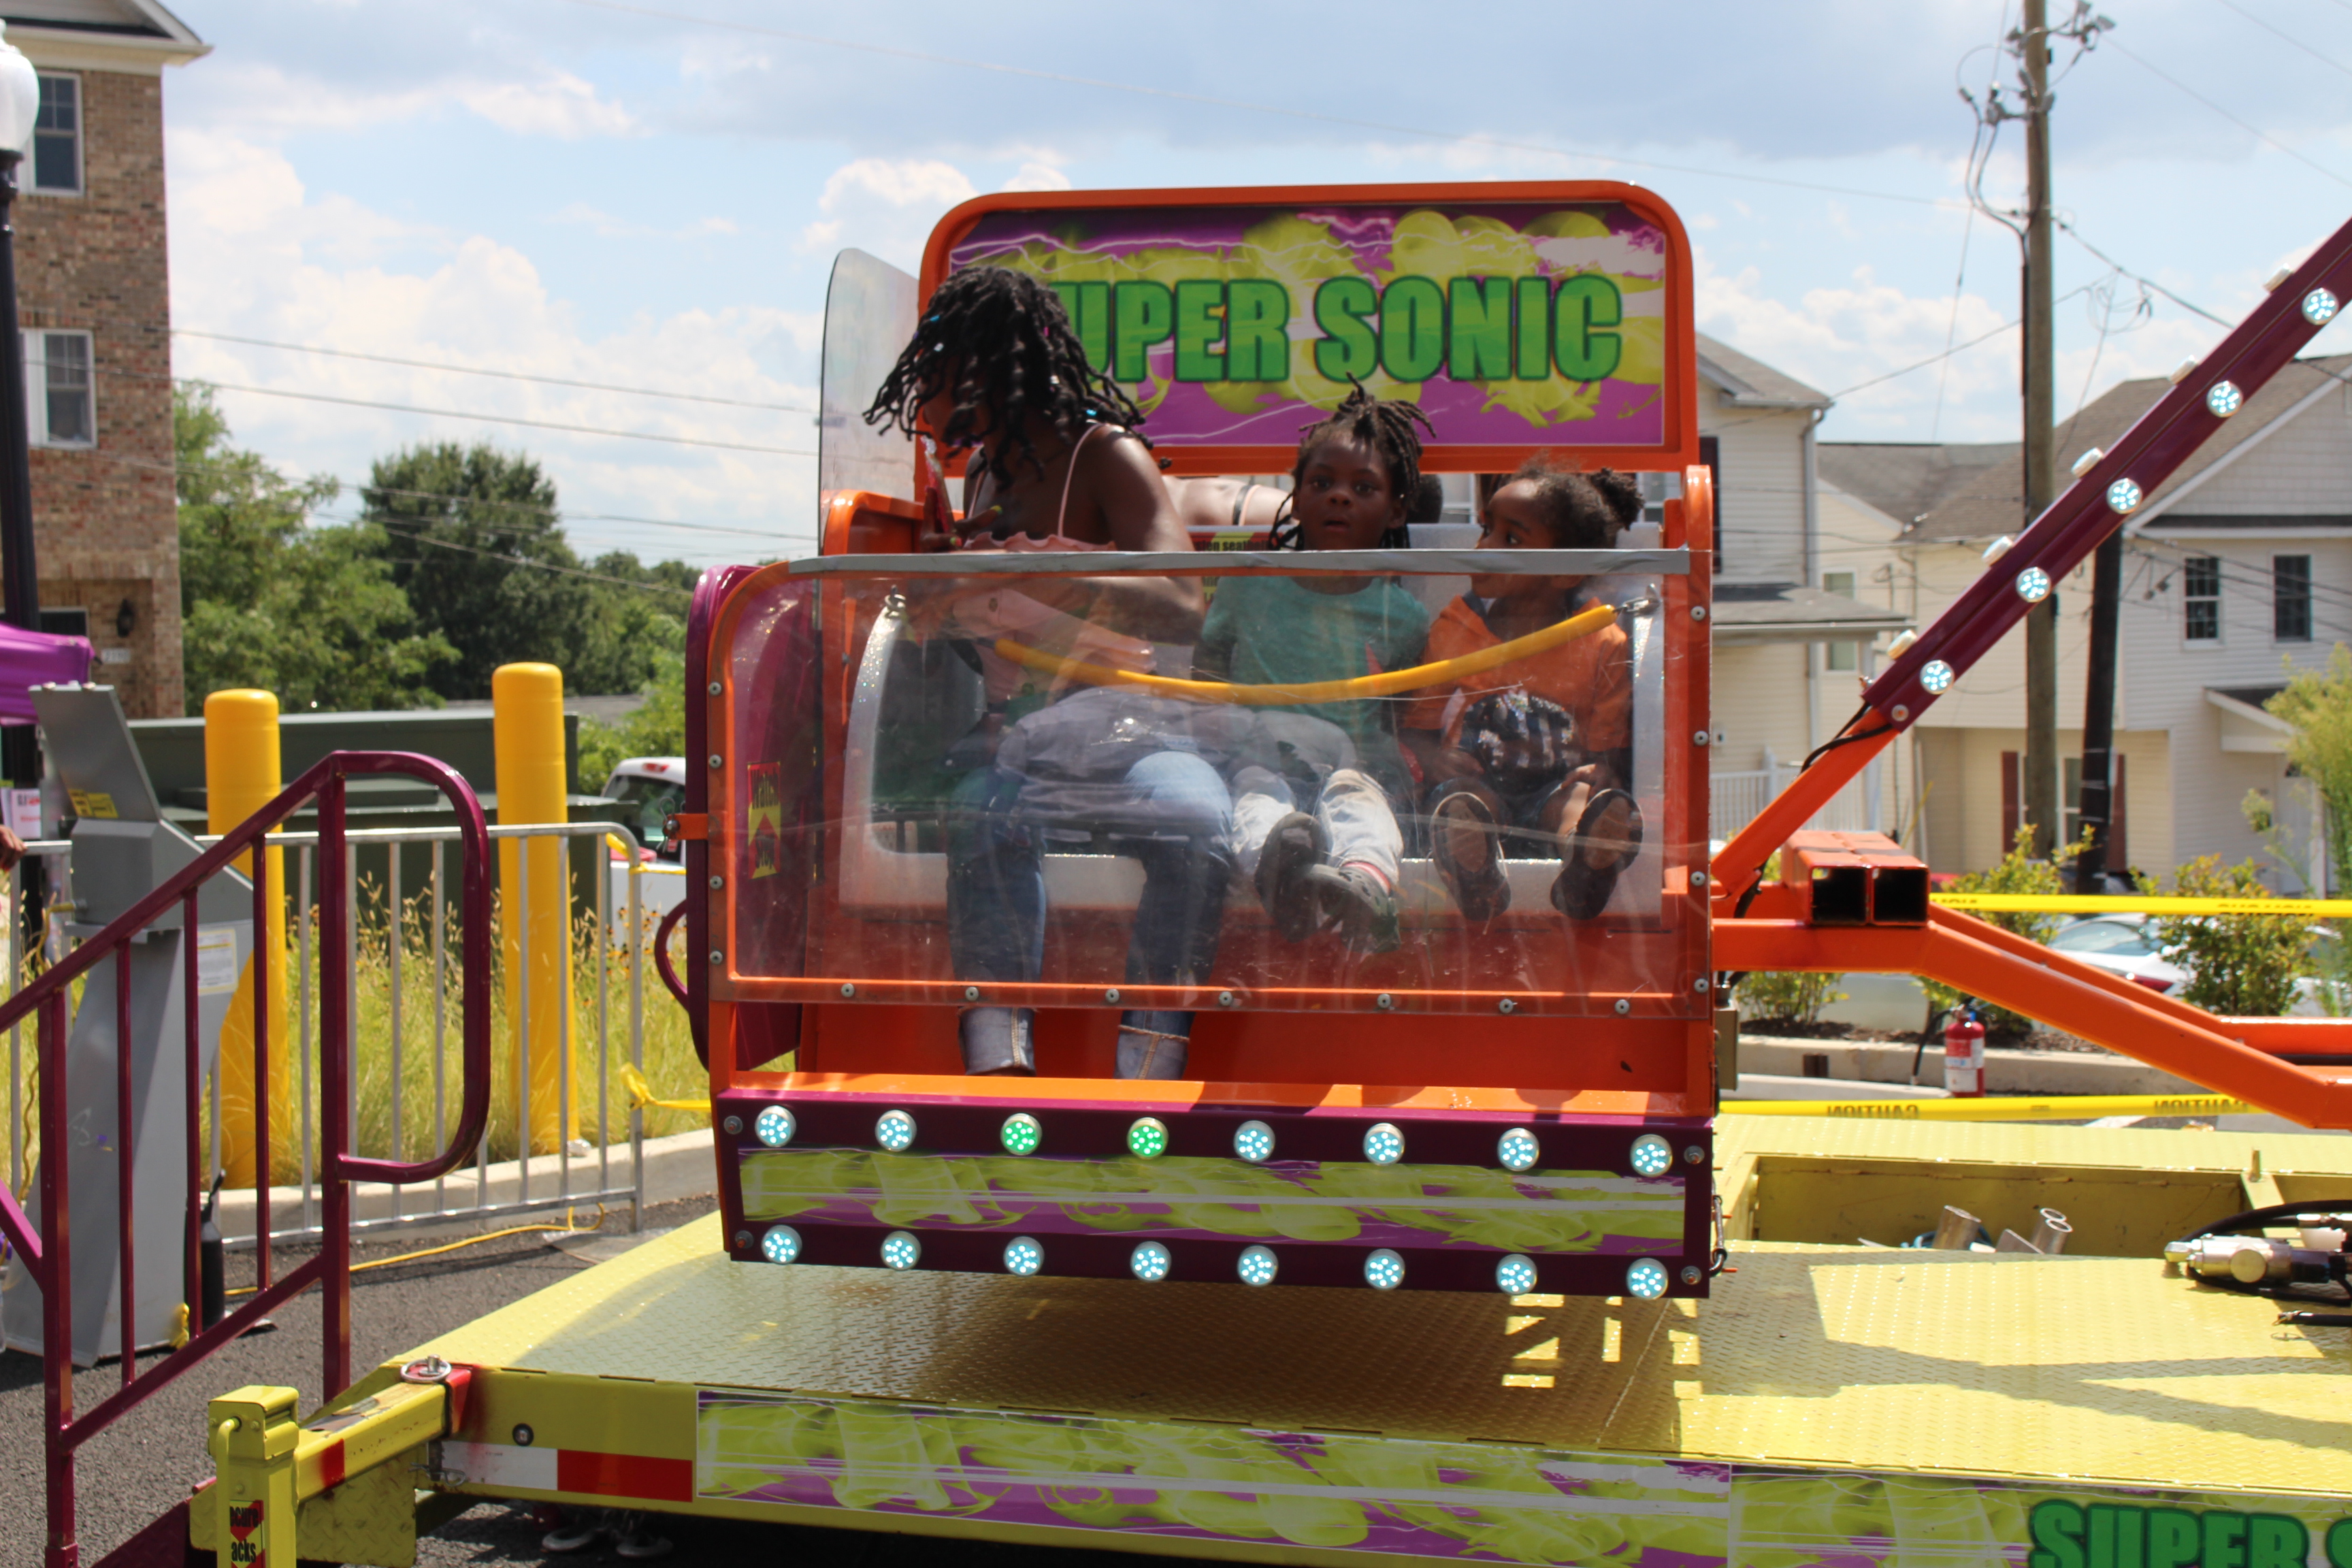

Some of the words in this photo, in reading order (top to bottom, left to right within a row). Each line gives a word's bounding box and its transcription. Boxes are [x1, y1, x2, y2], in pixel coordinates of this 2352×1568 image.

[1050, 280, 1290, 382] UPER
[1313, 275, 1622, 383] SONIC
[229, 1505, 259, 1529] ecure
[2029, 1499, 2309, 1568] SUPER
[231, 1538, 257, 1563] acks
